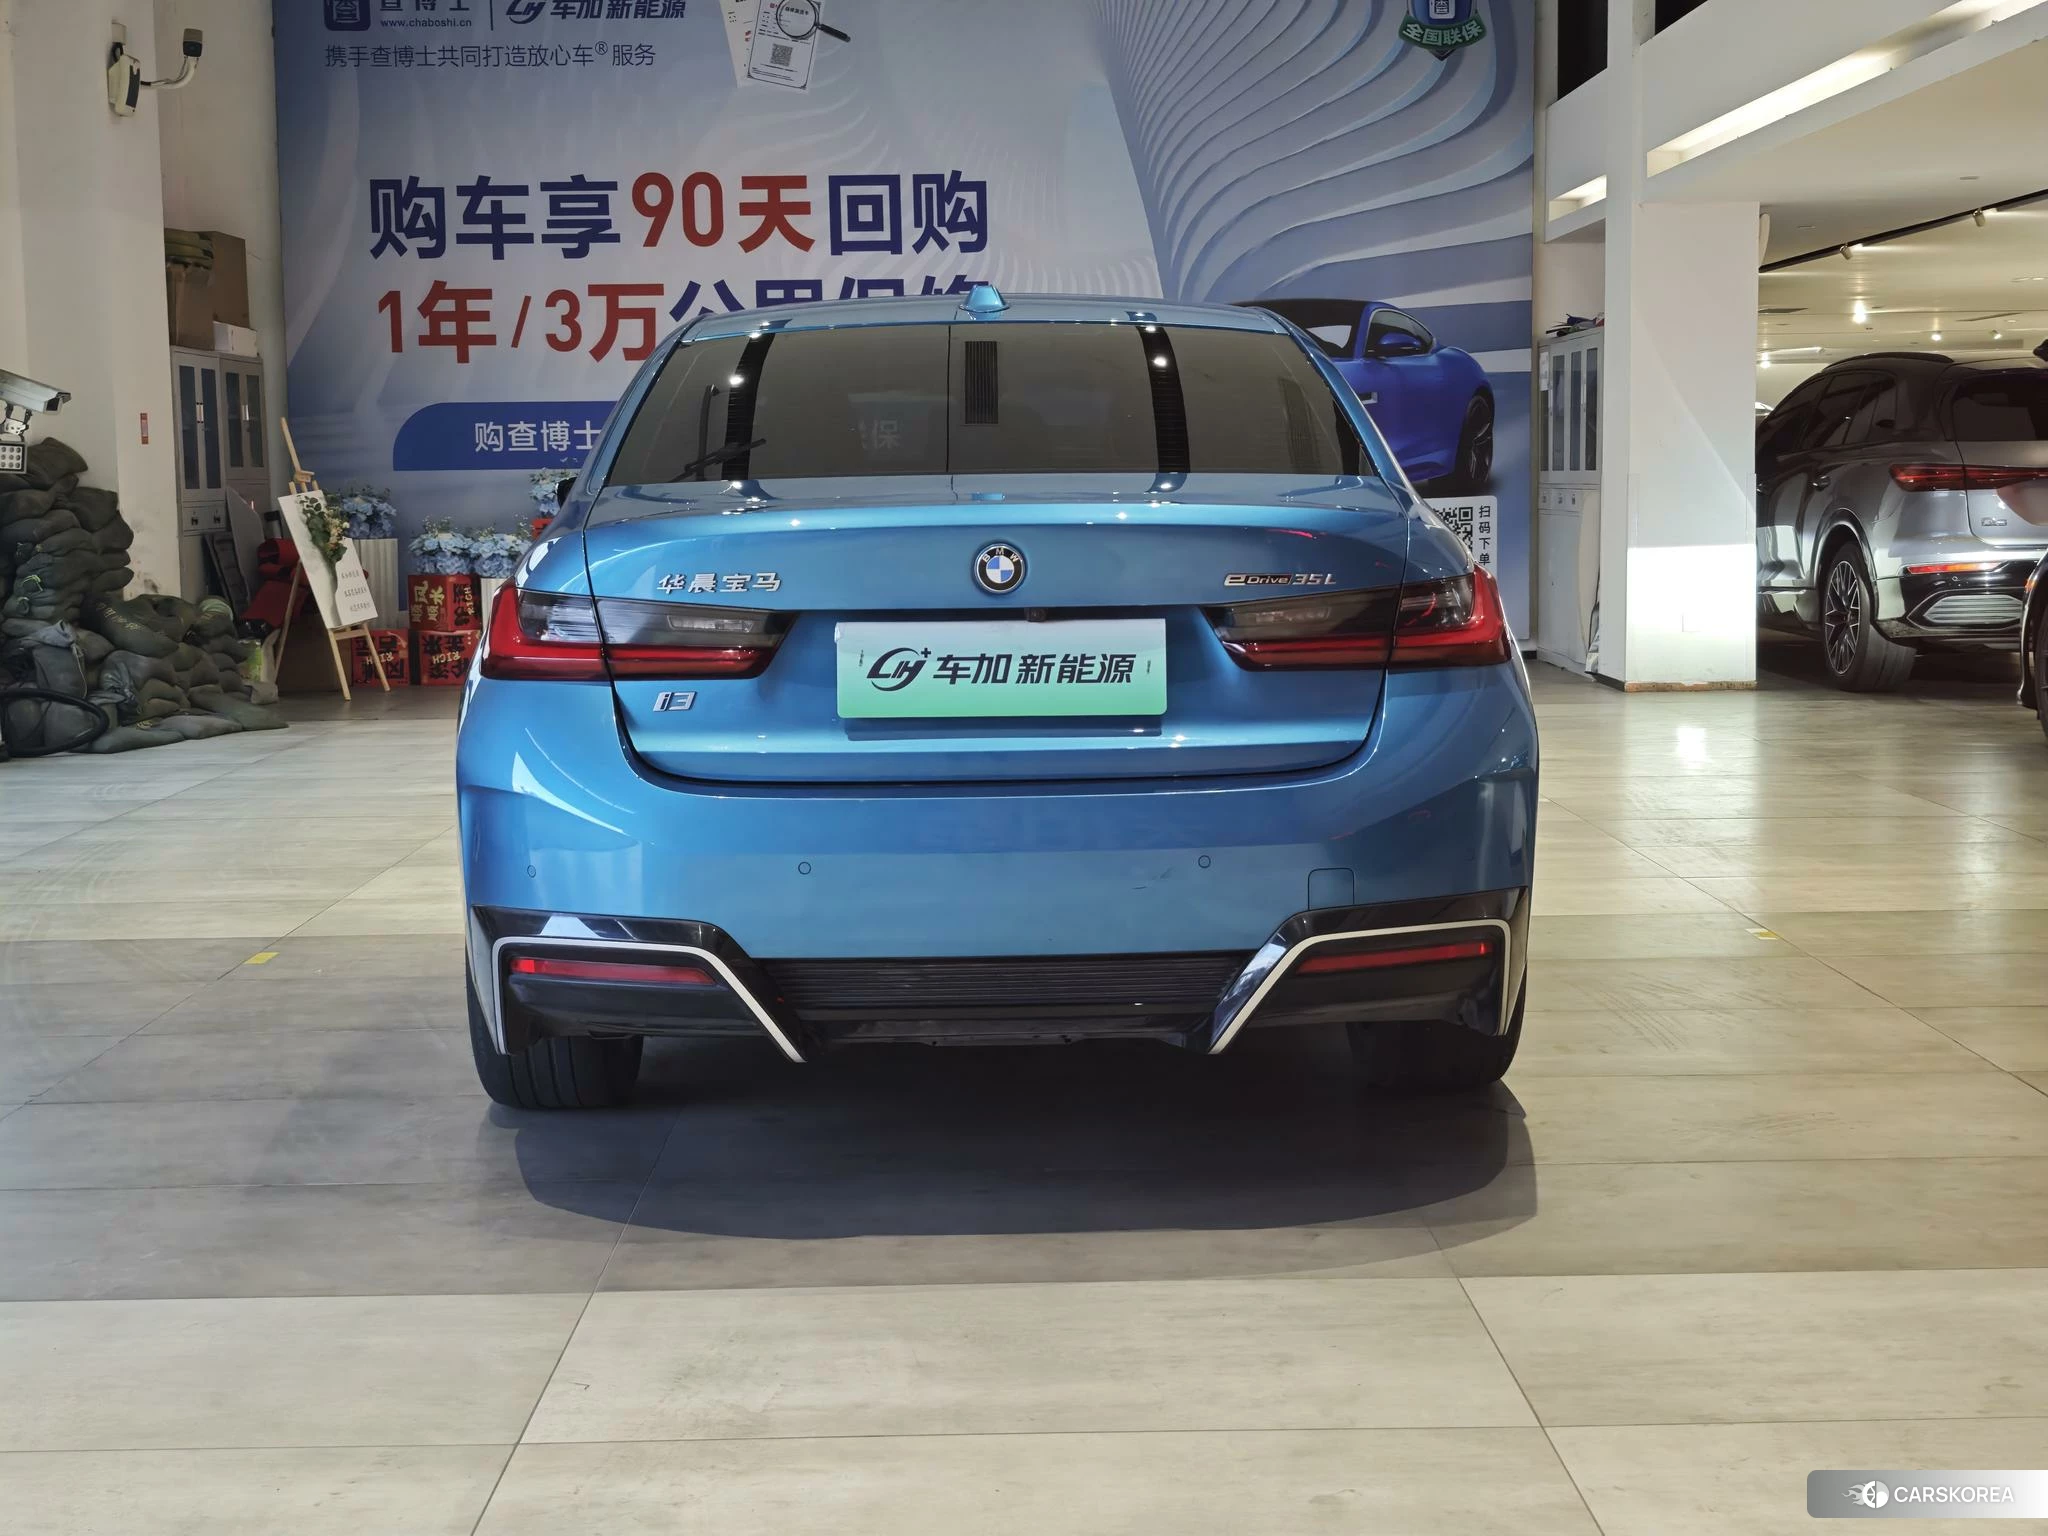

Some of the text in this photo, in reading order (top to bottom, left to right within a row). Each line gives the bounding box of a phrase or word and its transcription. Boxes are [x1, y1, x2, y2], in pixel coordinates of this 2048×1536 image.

[380, 18, 472, 27] www.chaboshi.cn
[1403, 21, 1482, 45] 全国联保
[368, 170, 989, 260] 购车享90天回购
[474, 420, 602, 452] 购查博士
[1478, 505, 1491, 566] 扫码下单
[656, 572, 782, 594] 华晨宝马
[366, 651, 395, 665] RIH
[431, 650, 461, 665] RICH
[932, 653, 1137, 685] 车加新能源
[653, 690, 698, 713] i3
